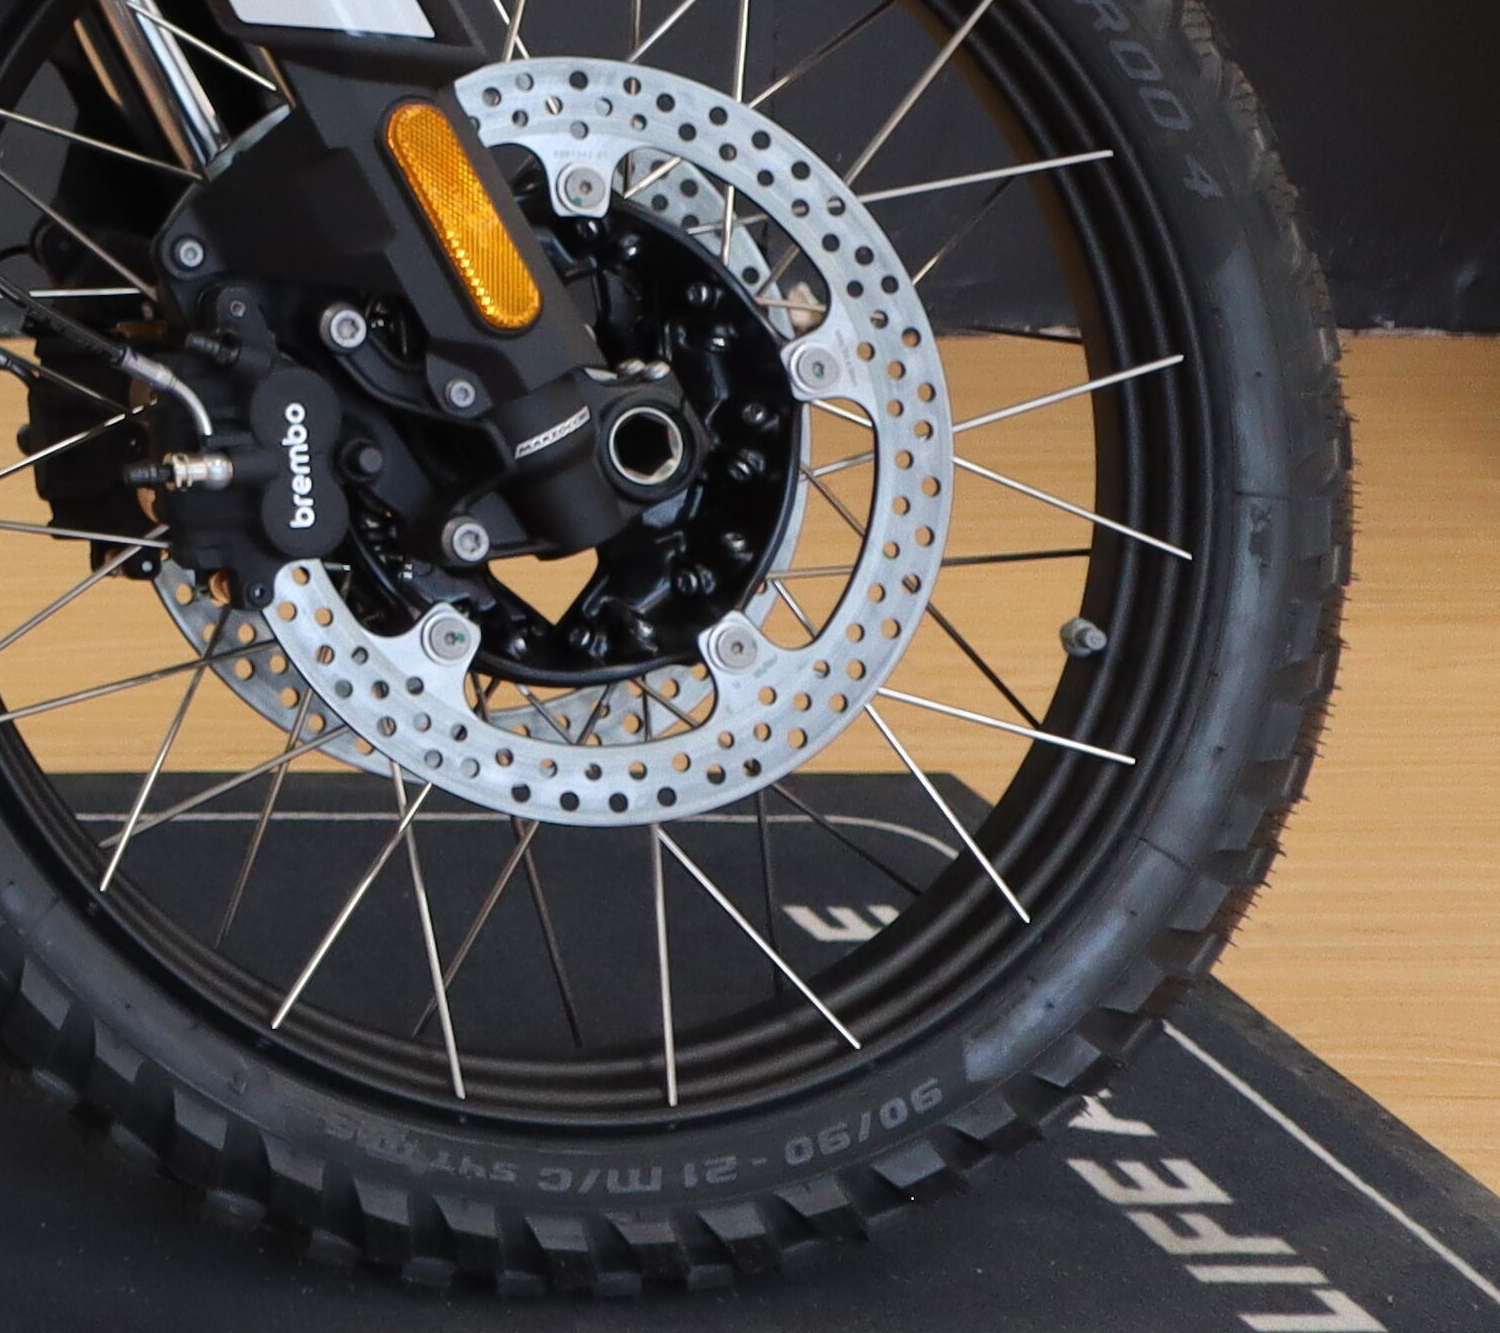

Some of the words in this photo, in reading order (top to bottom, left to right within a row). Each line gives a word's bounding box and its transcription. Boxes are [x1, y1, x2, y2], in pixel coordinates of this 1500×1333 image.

[1180, 152, 1226, 200] 4
[281, 402, 316, 529] brembo
[784, 1074, 944, 1168] 90/90
[538, 1149, 662, 1195] M/C
[682, 1153, 737, 1189] 21
[1067, 1158, 1387, 1332] LIFE
